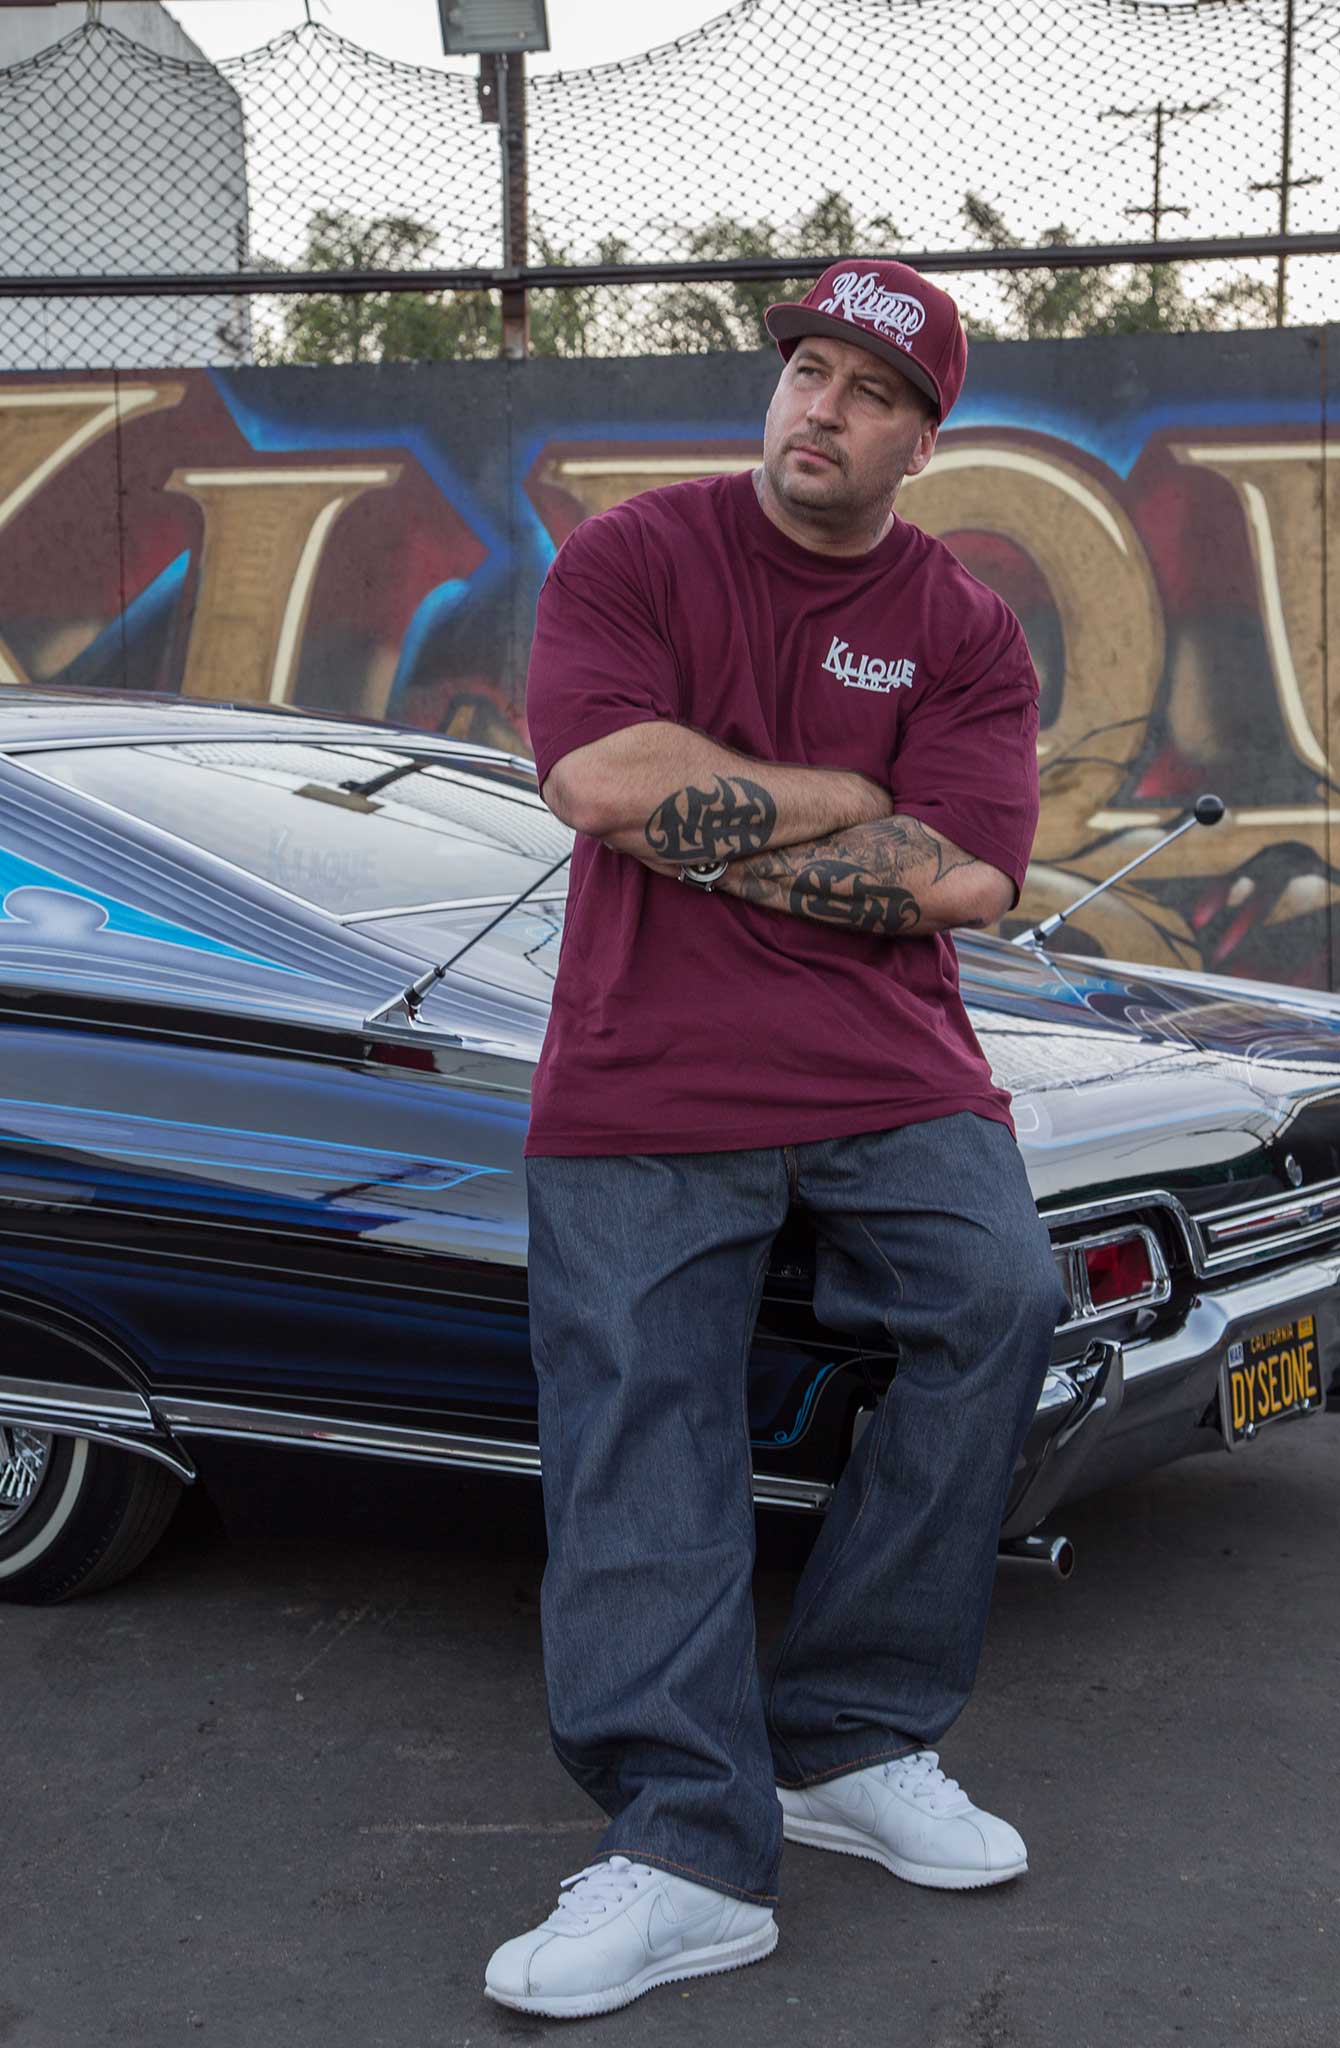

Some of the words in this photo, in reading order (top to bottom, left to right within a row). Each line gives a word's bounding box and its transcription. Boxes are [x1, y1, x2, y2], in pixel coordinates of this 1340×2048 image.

[821, 635, 916, 688] KLIQUE
[1251, 1323, 1294, 1353] CALIFORNIA
[1231, 1341, 1317, 1429] DYSEONE
